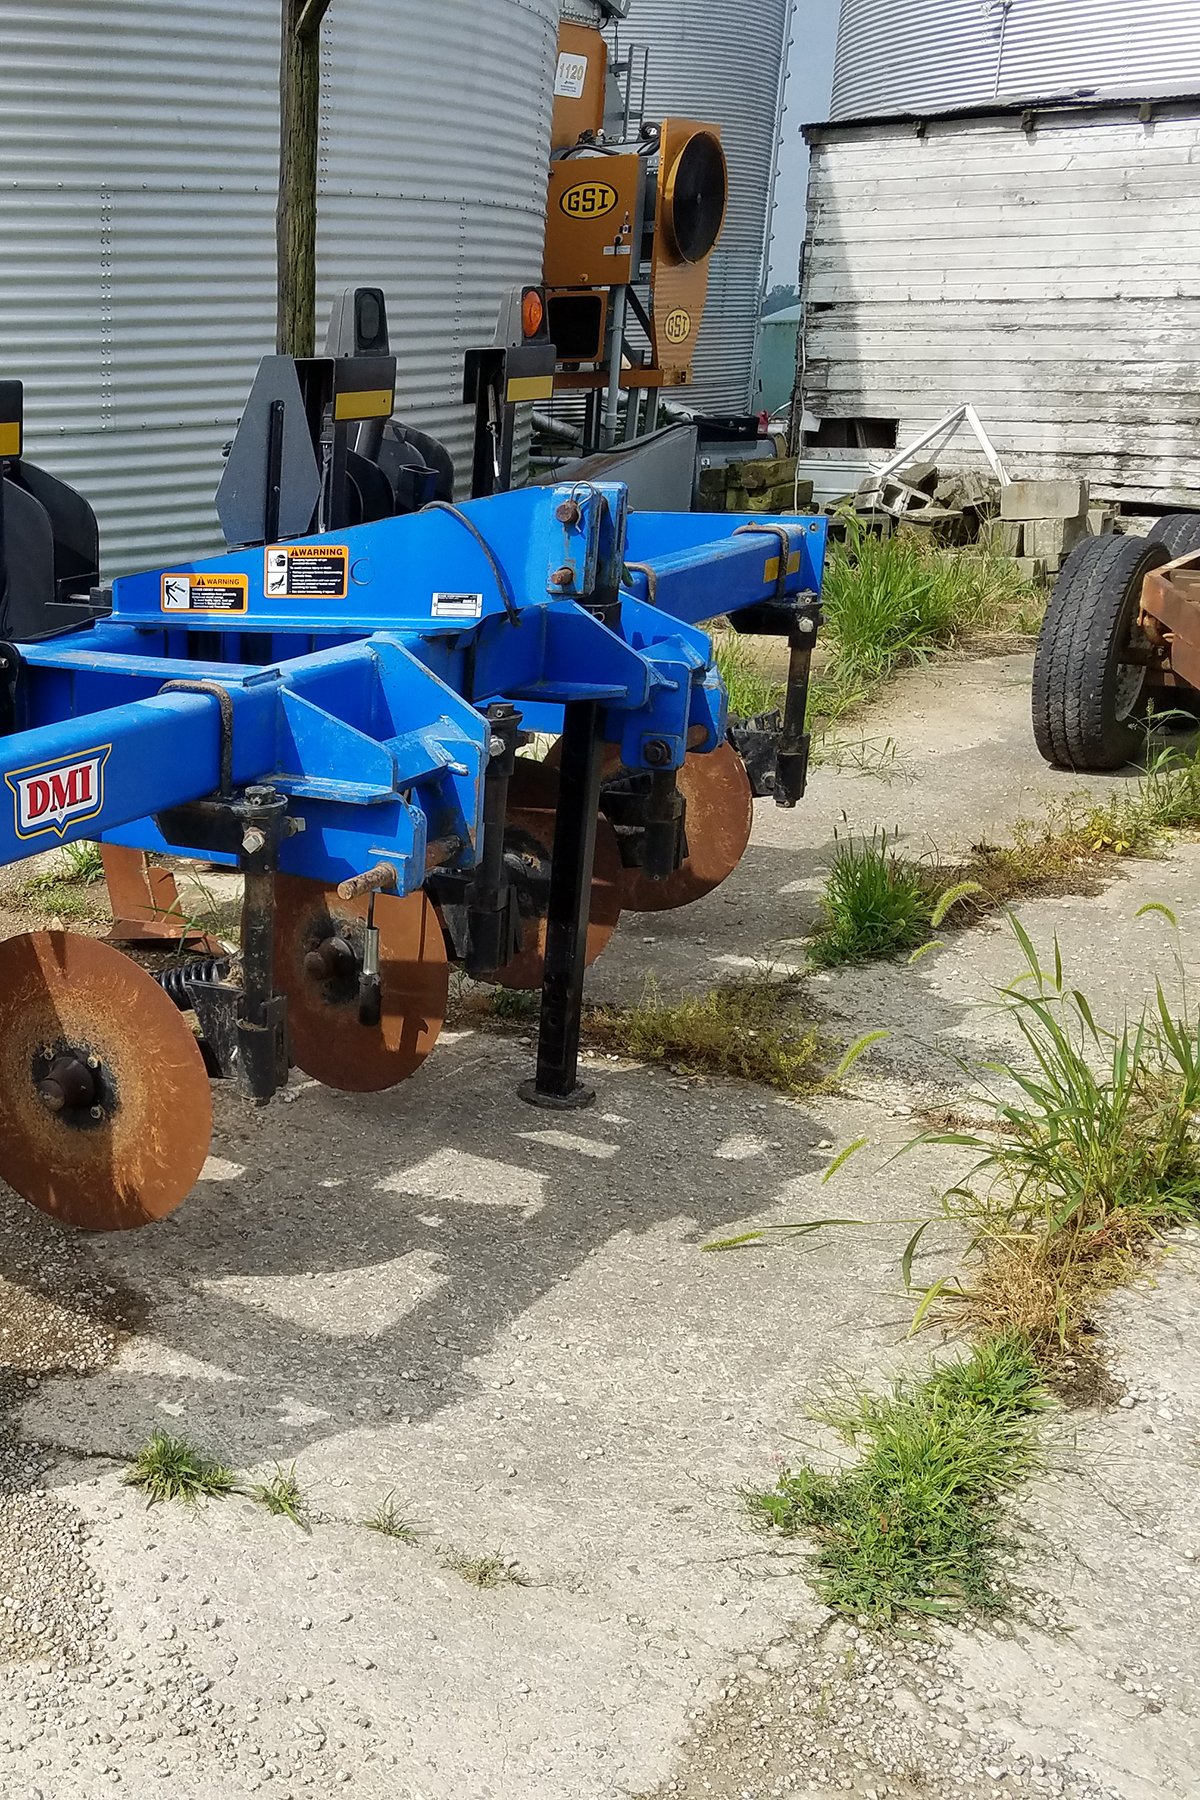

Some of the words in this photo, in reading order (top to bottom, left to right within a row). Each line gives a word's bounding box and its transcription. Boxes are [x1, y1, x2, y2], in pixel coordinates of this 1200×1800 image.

[560, 63, 584, 80] 1120
[568, 188, 609, 212] GSI
[668, 315, 687, 337] GSI
[299, 548, 343, 556] WARNING
[27, 765, 92, 819] DMI
